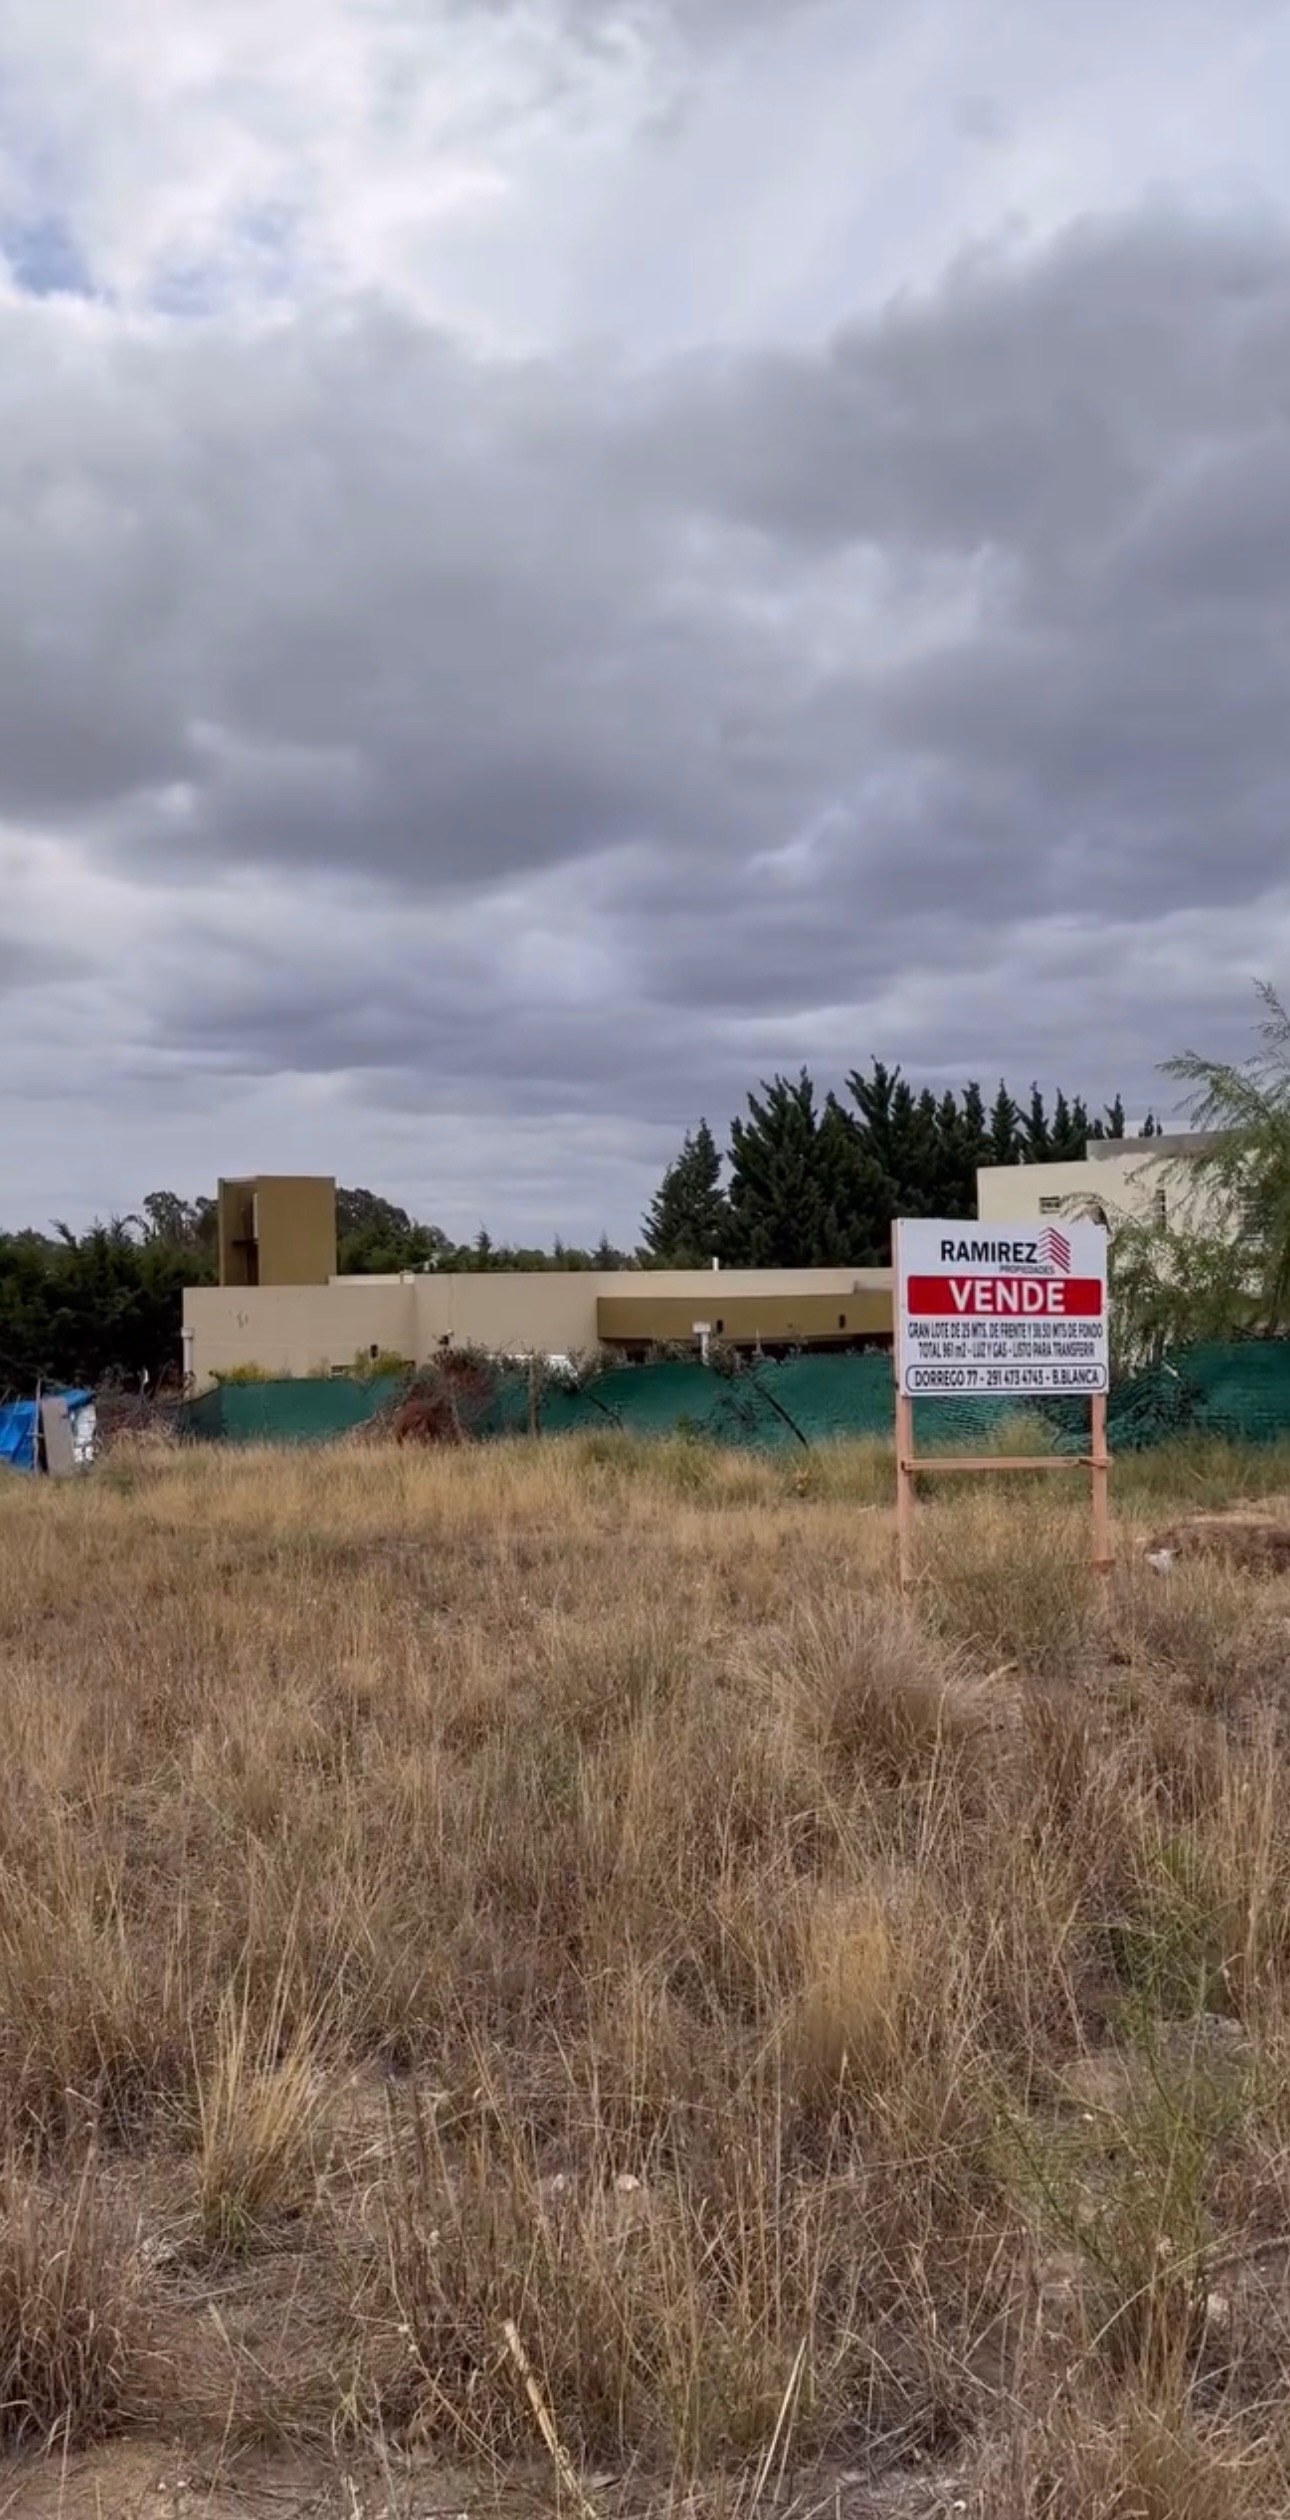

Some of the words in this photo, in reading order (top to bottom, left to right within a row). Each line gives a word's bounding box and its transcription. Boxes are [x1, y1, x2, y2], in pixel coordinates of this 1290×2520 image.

[941, 1239, 1038, 1264] RAMIREZ
[999, 1264, 1055, 1275] PROPIEDADES
[948, 1279, 1065, 1313] VENDE
[908, 1322, 930, 1338] GRAN
[931, 1322, 948, 1338] LOTE
[950, 1322, 960, 1338] DE
[989, 1322, 999, 1338] DE
[1000, 1322, 1026, 1338] FRENTE
[1026, 1322, 1032, 1338] Y
[1068, 1322, 1077, 1338] DE
[1078, 1322, 1103, 1339] FONDO
[918, 1342, 941, 1358] TOTAL
[973, 1342, 986, 1358] LUZ
[986, 1342, 992, 1358] Y
[993, 1342, 1007, 1358] GAS
[1013, 1342, 1031, 1357] LISTO
[1033, 1342, 1051, 1357] PARA
[1053, 1341, 1095, 1357] TRANSFERIR
[915, 1369, 966, 1387] DORREGO
[966, 1369, 978, 1386] 77
[987, 1369, 1002, 1386] 291
